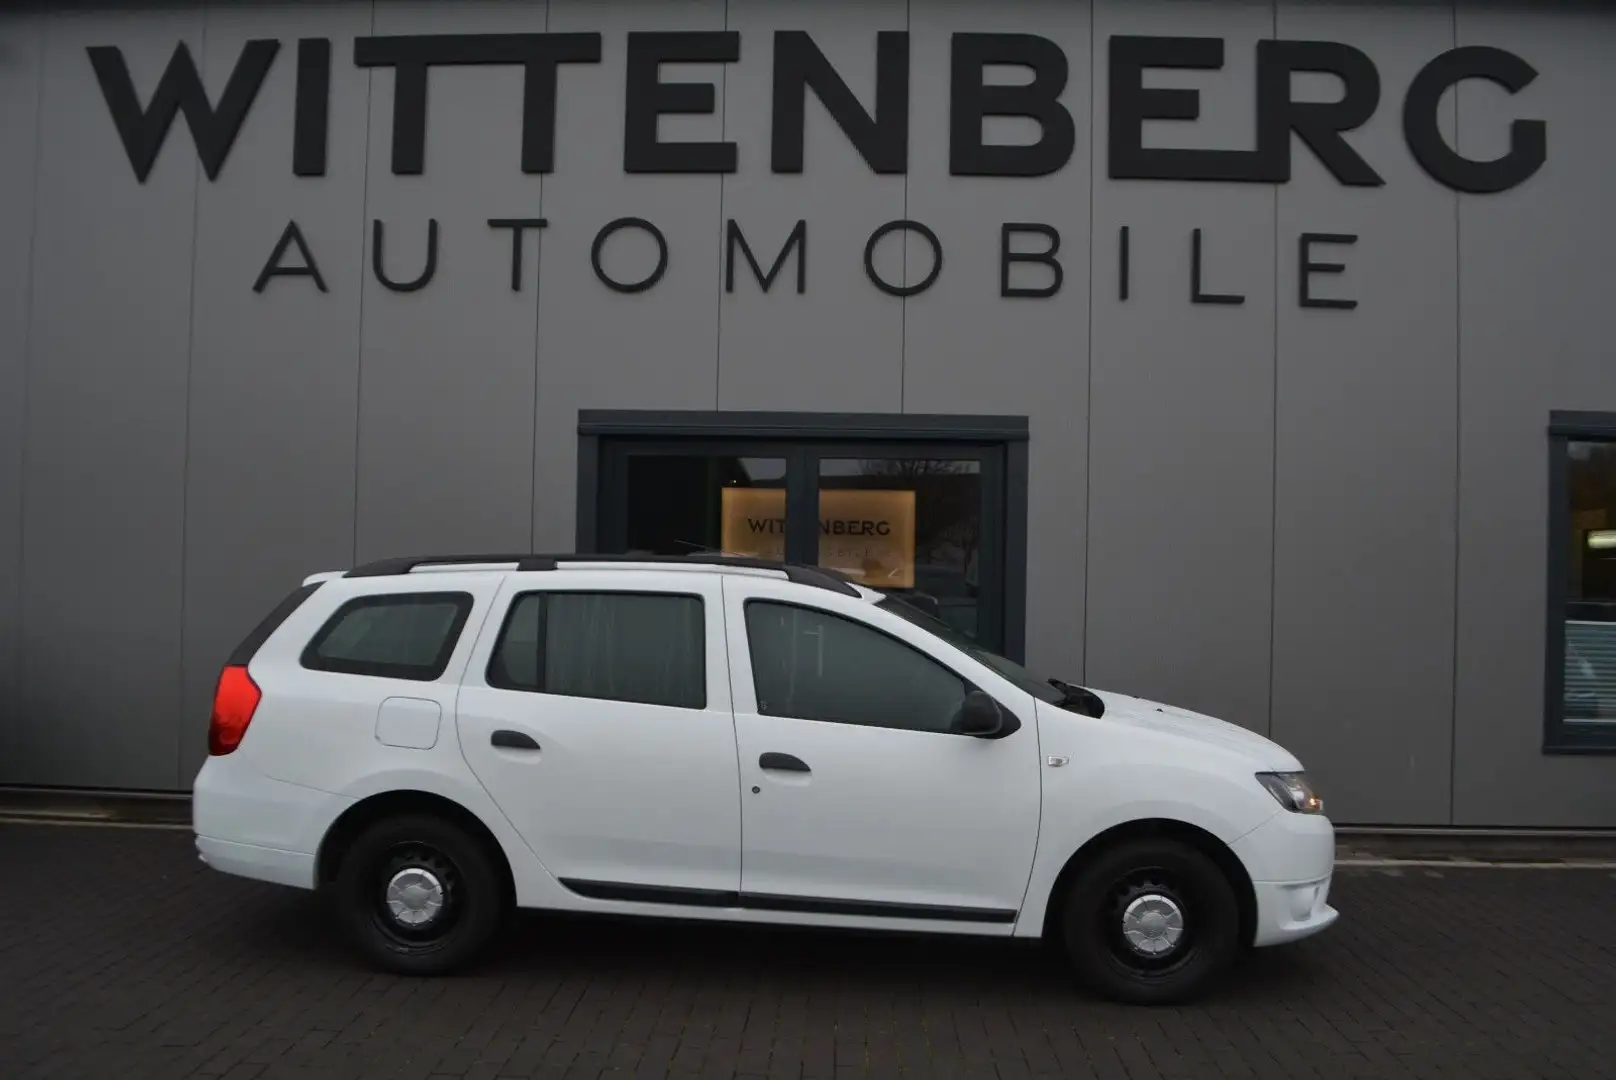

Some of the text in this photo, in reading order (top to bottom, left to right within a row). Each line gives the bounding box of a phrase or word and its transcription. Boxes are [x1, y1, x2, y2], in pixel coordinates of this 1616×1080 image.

[85, 30, 1547, 194] WITTENBERG
[253, 217, 1359, 310] AUTOMOBILE
[747, 518, 891, 537] WITNBERG
